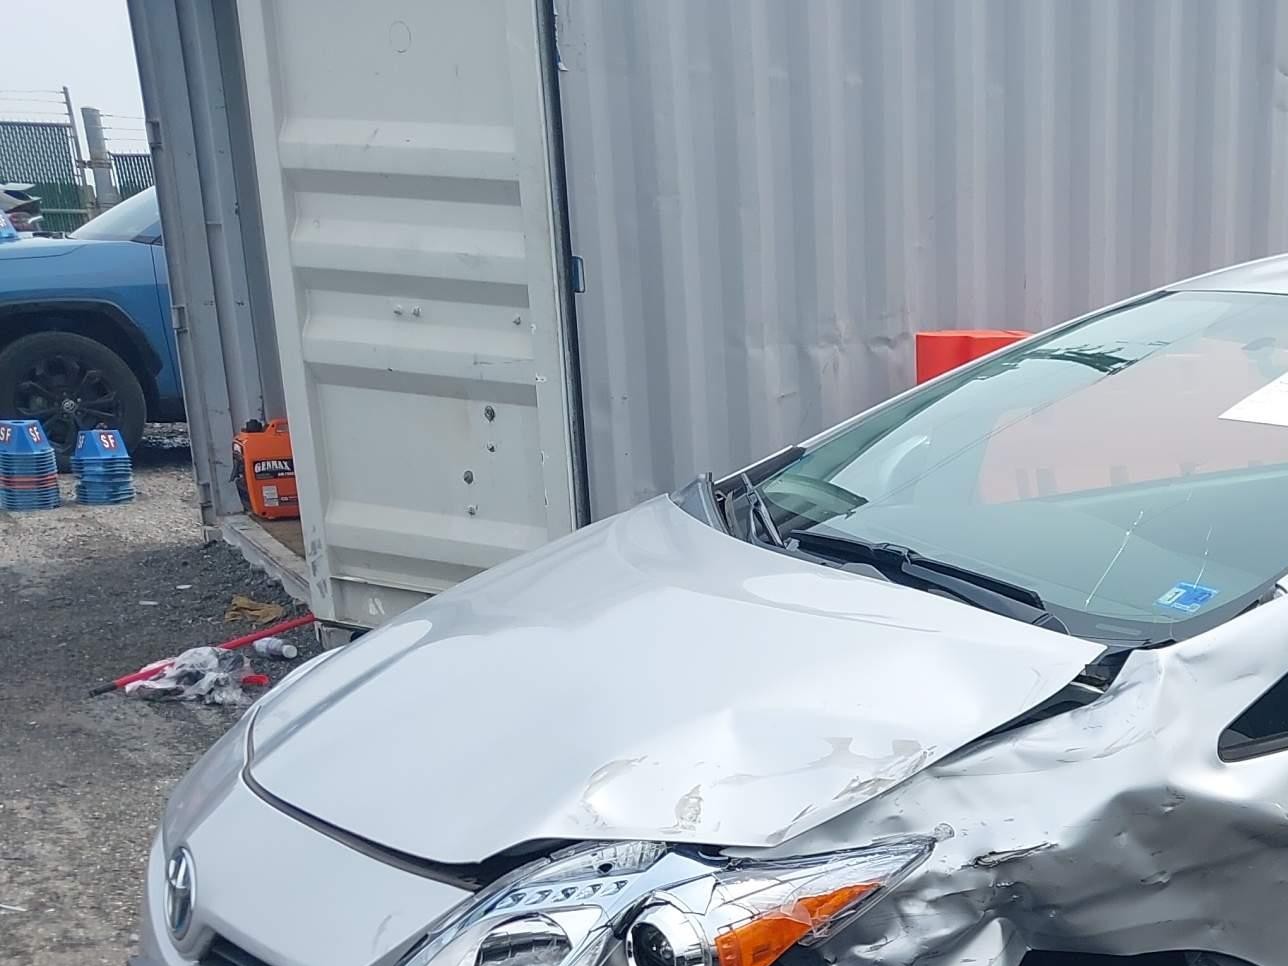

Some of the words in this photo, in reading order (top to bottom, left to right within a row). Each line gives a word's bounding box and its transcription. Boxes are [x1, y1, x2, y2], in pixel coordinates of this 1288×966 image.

[0, 426, 11, 441] SF
[28, 426, 41, 442] SF
[100, 434, 115, 448] SF
[254, 460, 292, 473] GENMAX
